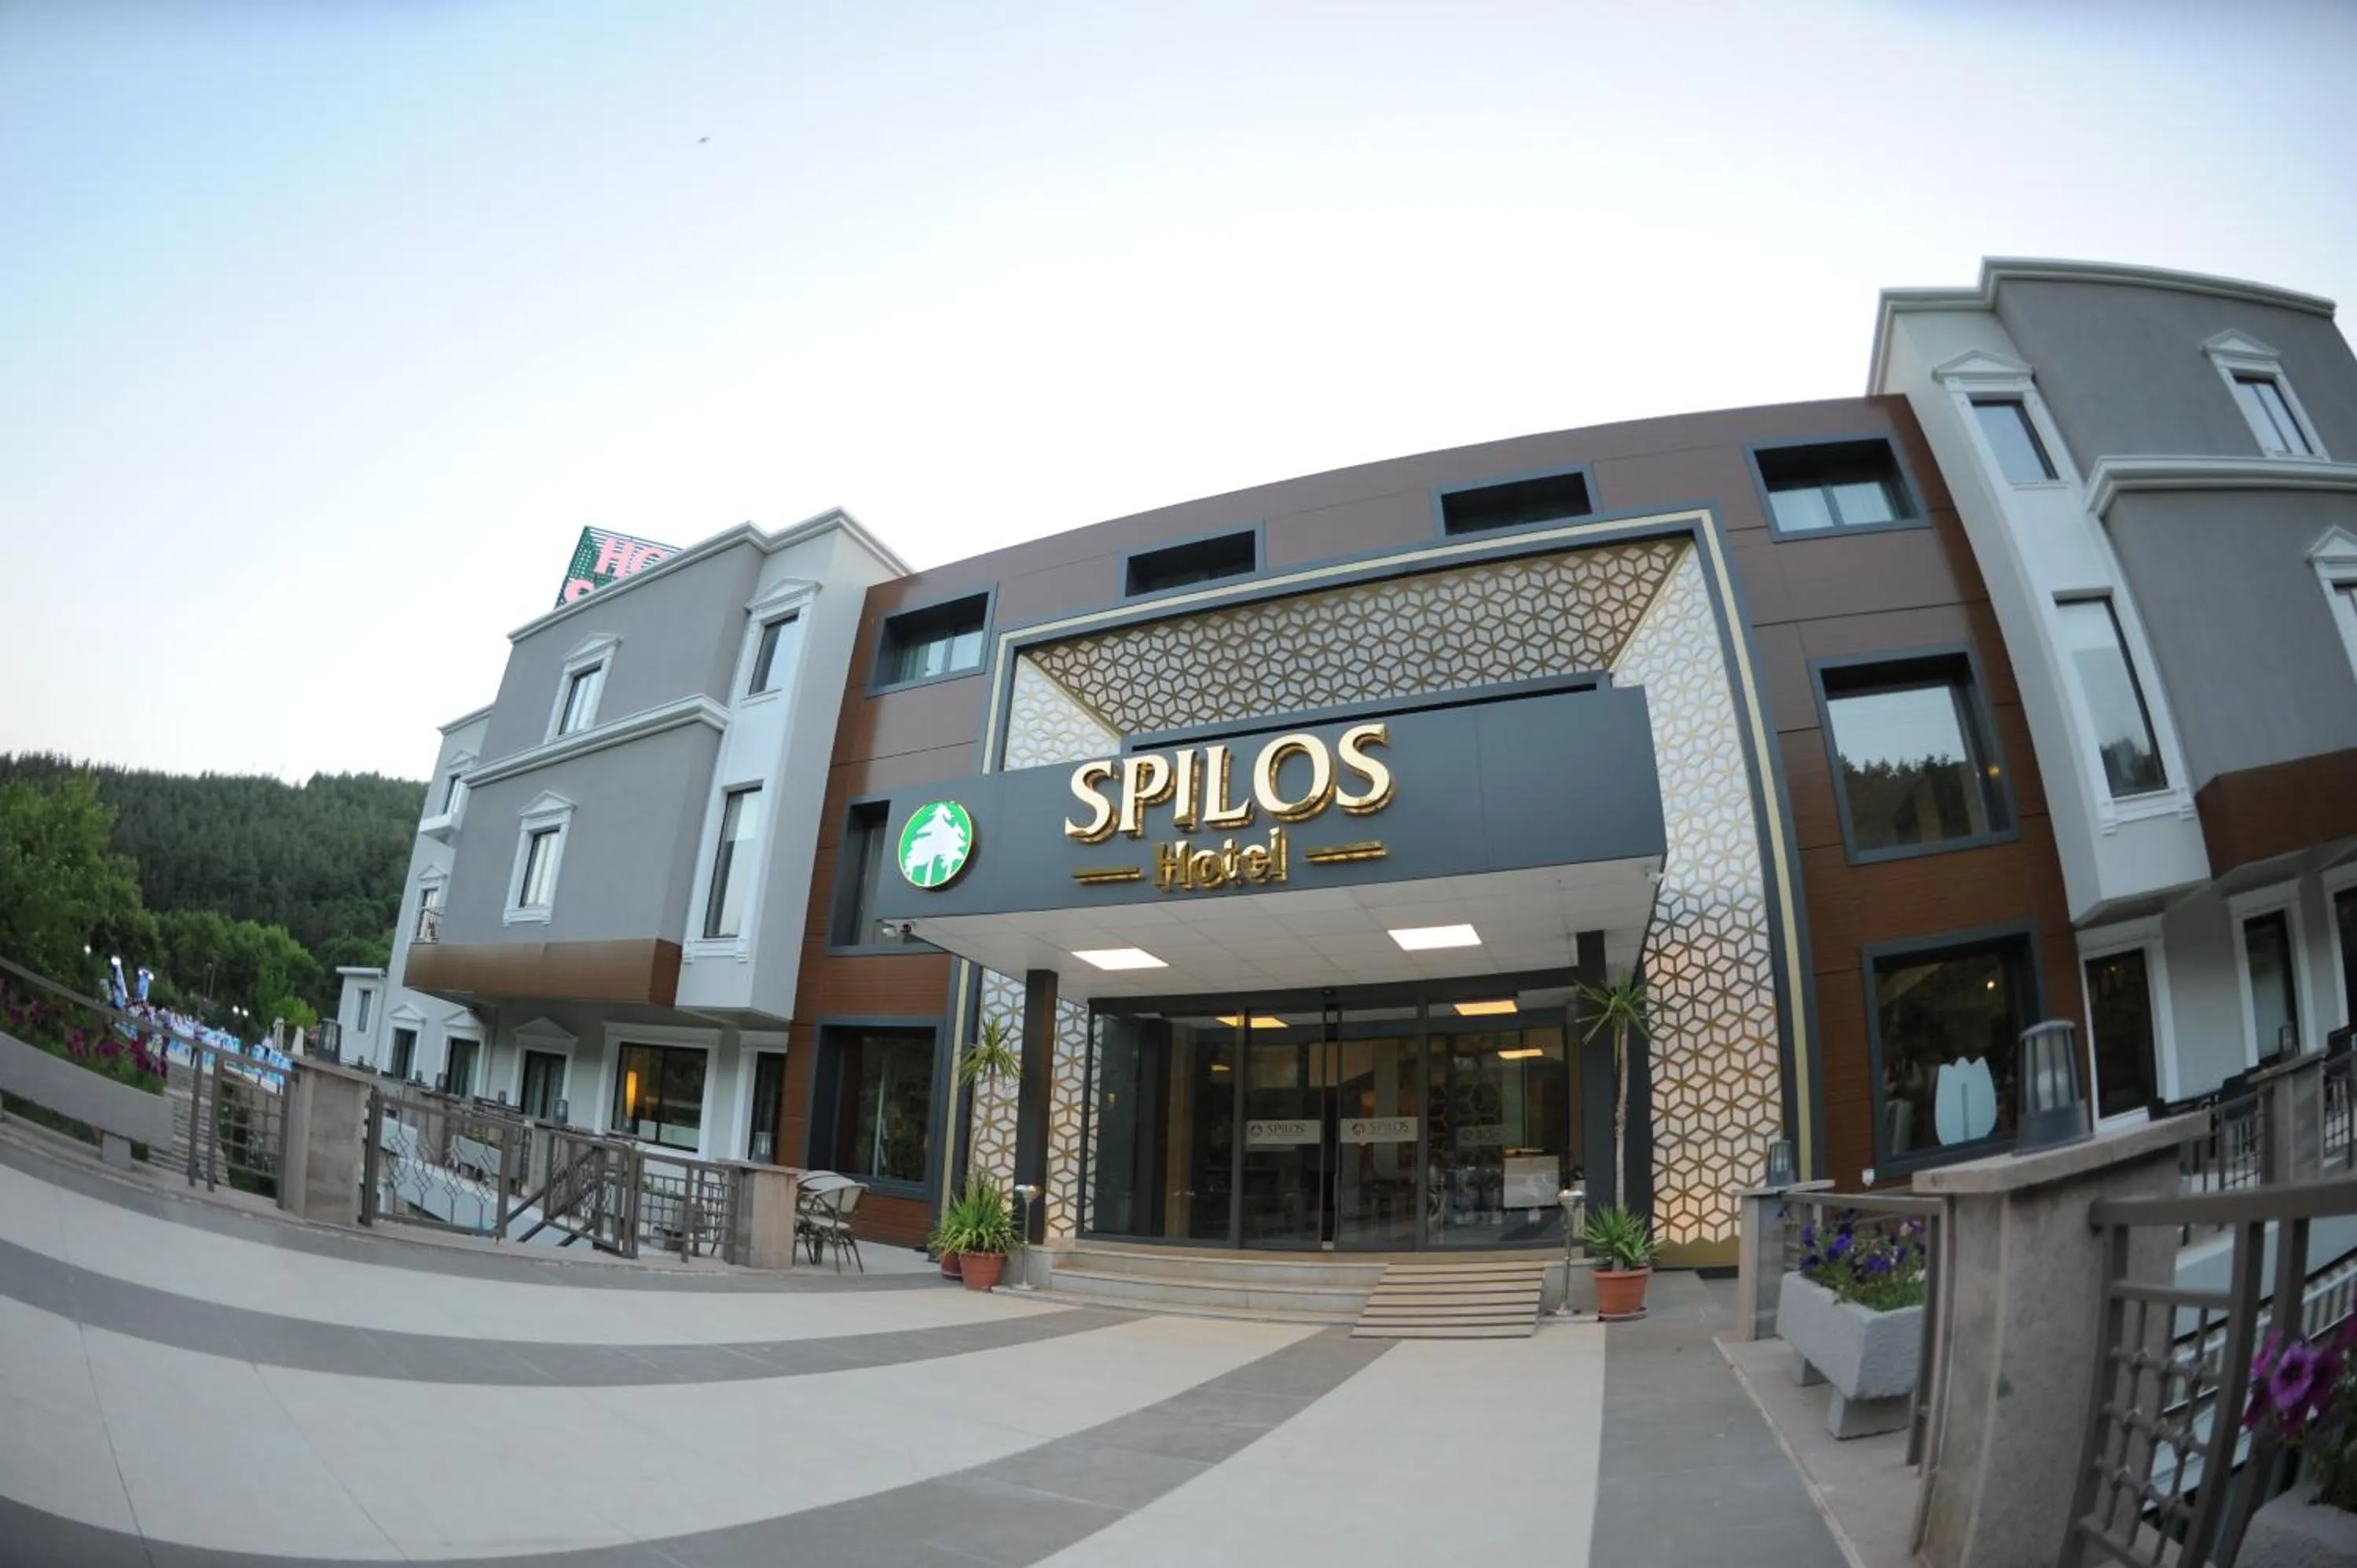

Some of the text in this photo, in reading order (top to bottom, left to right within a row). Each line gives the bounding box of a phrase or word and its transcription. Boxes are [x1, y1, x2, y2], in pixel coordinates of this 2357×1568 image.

[1065, 723, 1395, 843] SPILOS
[1153, 826, 1288, 891] Hotel
[1266, 1122, 1306, 1134] SPILOS
[1370, 1120, 1409, 1133] SPILOS
